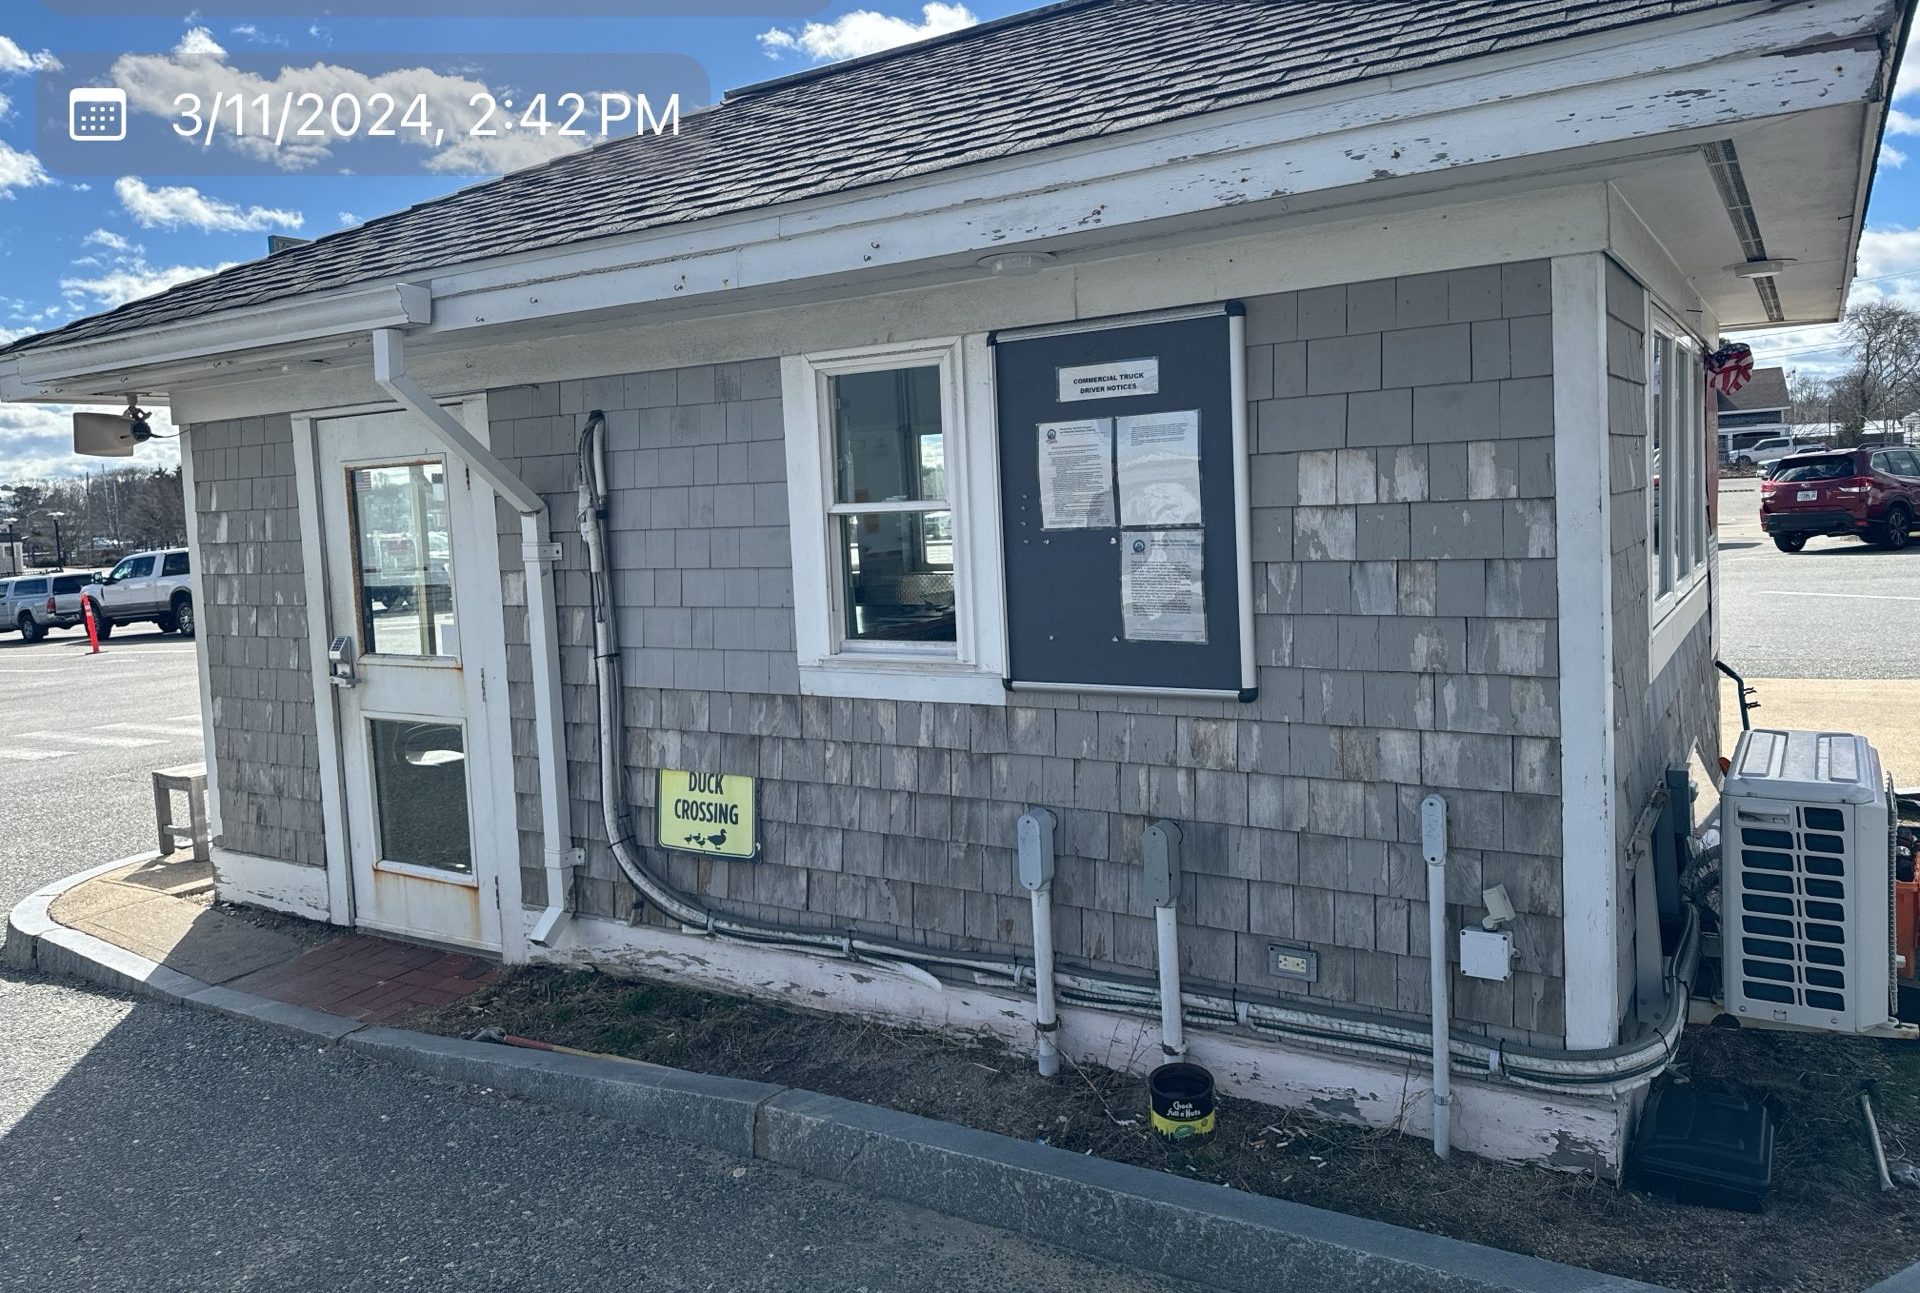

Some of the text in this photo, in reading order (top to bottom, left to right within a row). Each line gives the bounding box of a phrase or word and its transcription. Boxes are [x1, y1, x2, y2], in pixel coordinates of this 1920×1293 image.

[1073, 372, 1144, 384] COMMERCIAL TRUCK
[1080, 383, 1137, 394] DRIVER NOTICES
[689, 771, 724, 794] DUCK
[674, 798, 739, 825] CROSSING
[1173, 1101, 1193, 1110] Chock
